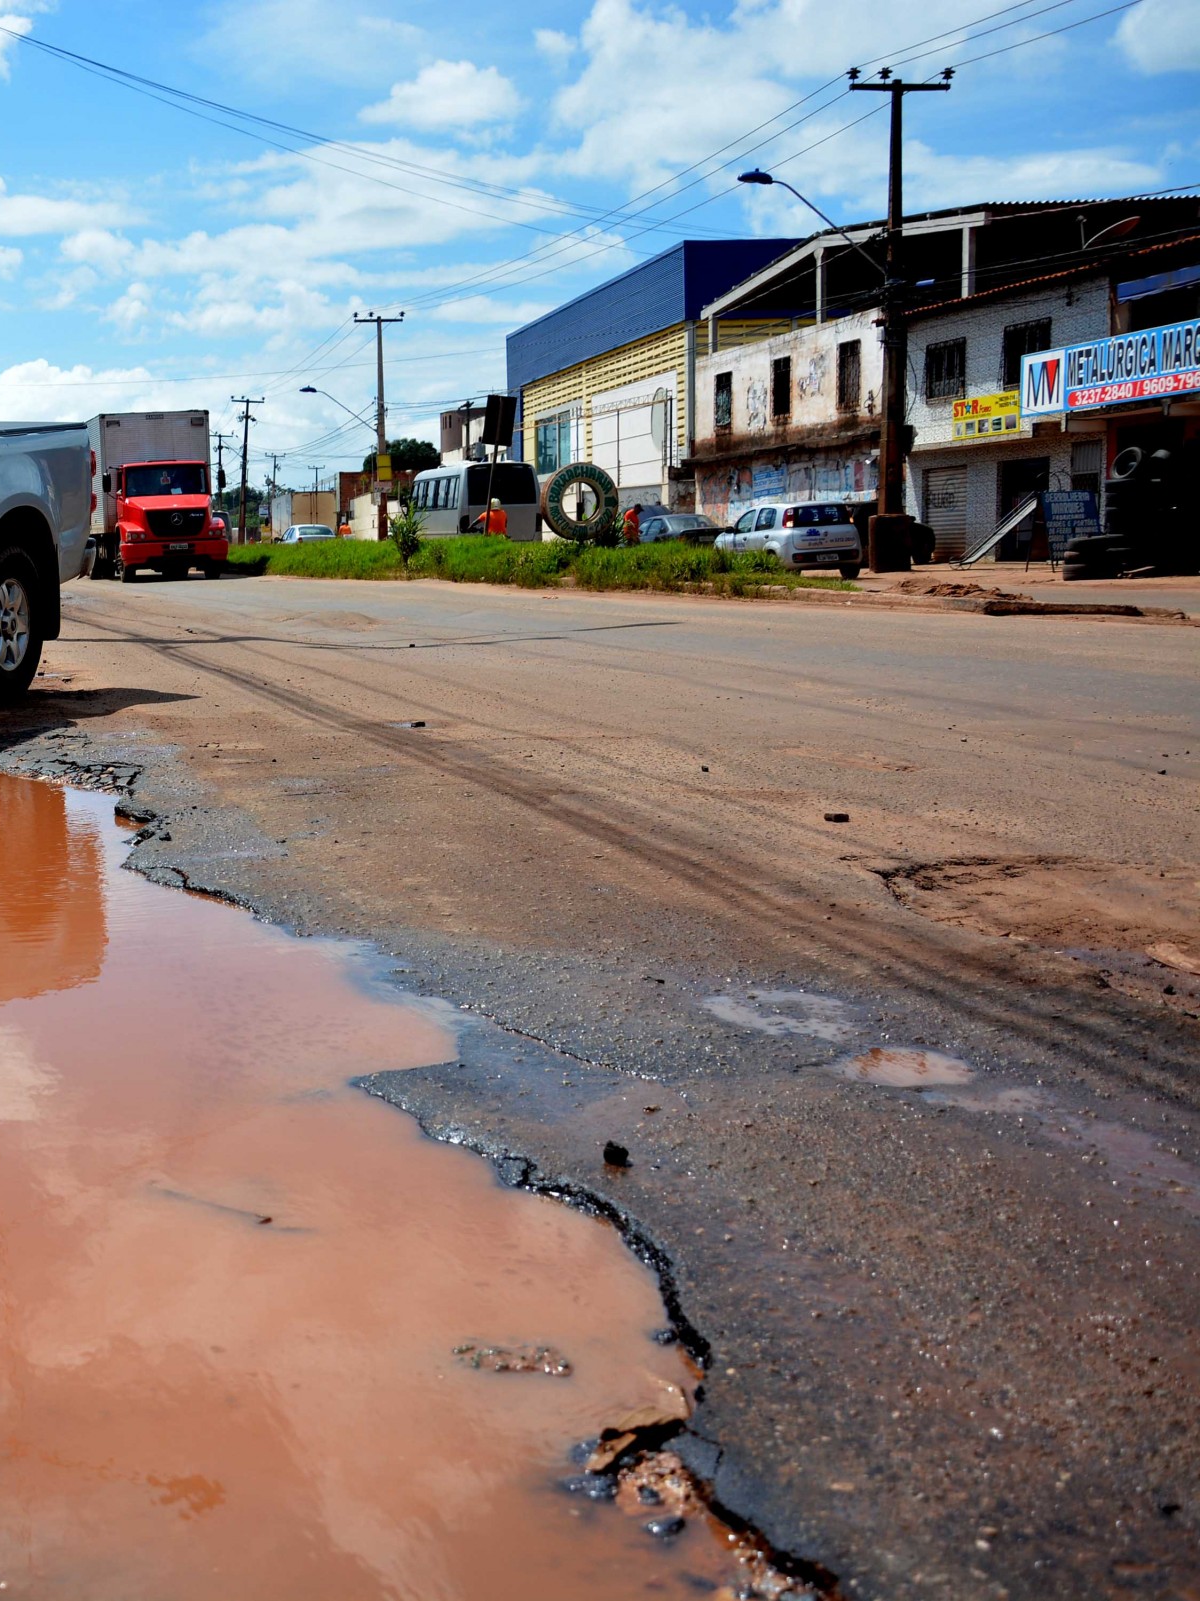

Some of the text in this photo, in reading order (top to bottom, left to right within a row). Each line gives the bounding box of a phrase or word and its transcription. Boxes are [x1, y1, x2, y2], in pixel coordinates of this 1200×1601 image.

[1066, 332, 1158, 390] METALÚRGICA
[1075, 382, 1133, 406] 3237-2840
[548, 465, 614, 503] BORRACHARIA
